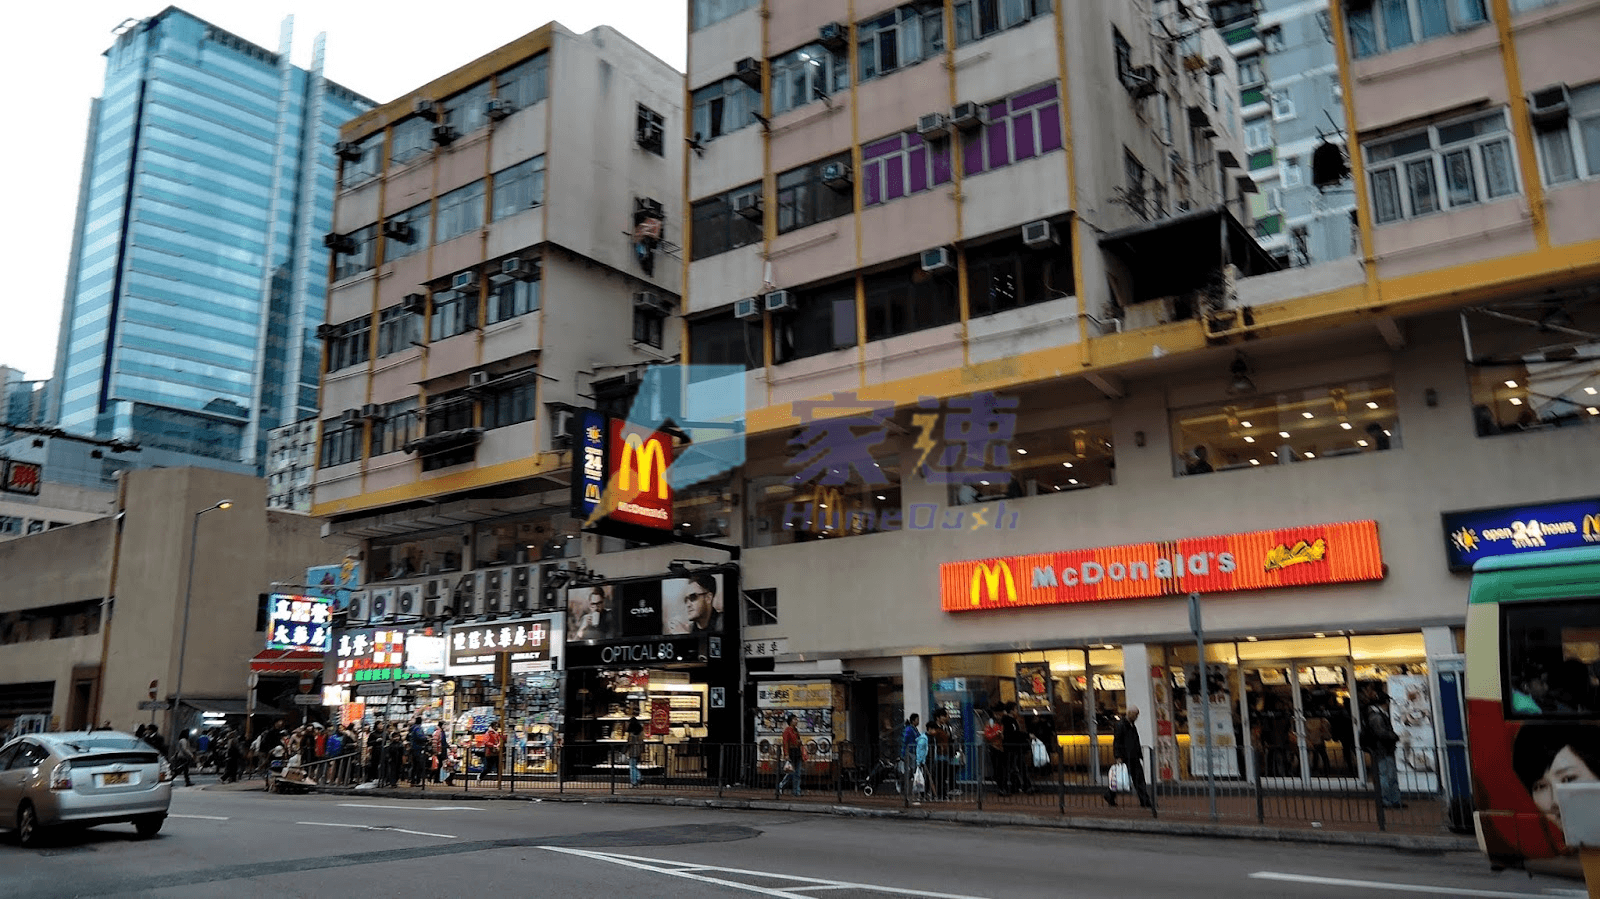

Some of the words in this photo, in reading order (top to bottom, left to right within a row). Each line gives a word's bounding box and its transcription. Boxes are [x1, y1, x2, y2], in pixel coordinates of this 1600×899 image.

[1511, 520, 1546, 548] 24
[1031, 551, 1237, 589] McDonald's
[601, 644, 657, 663] OPTICAL
[658, 642, 675, 659] 88
